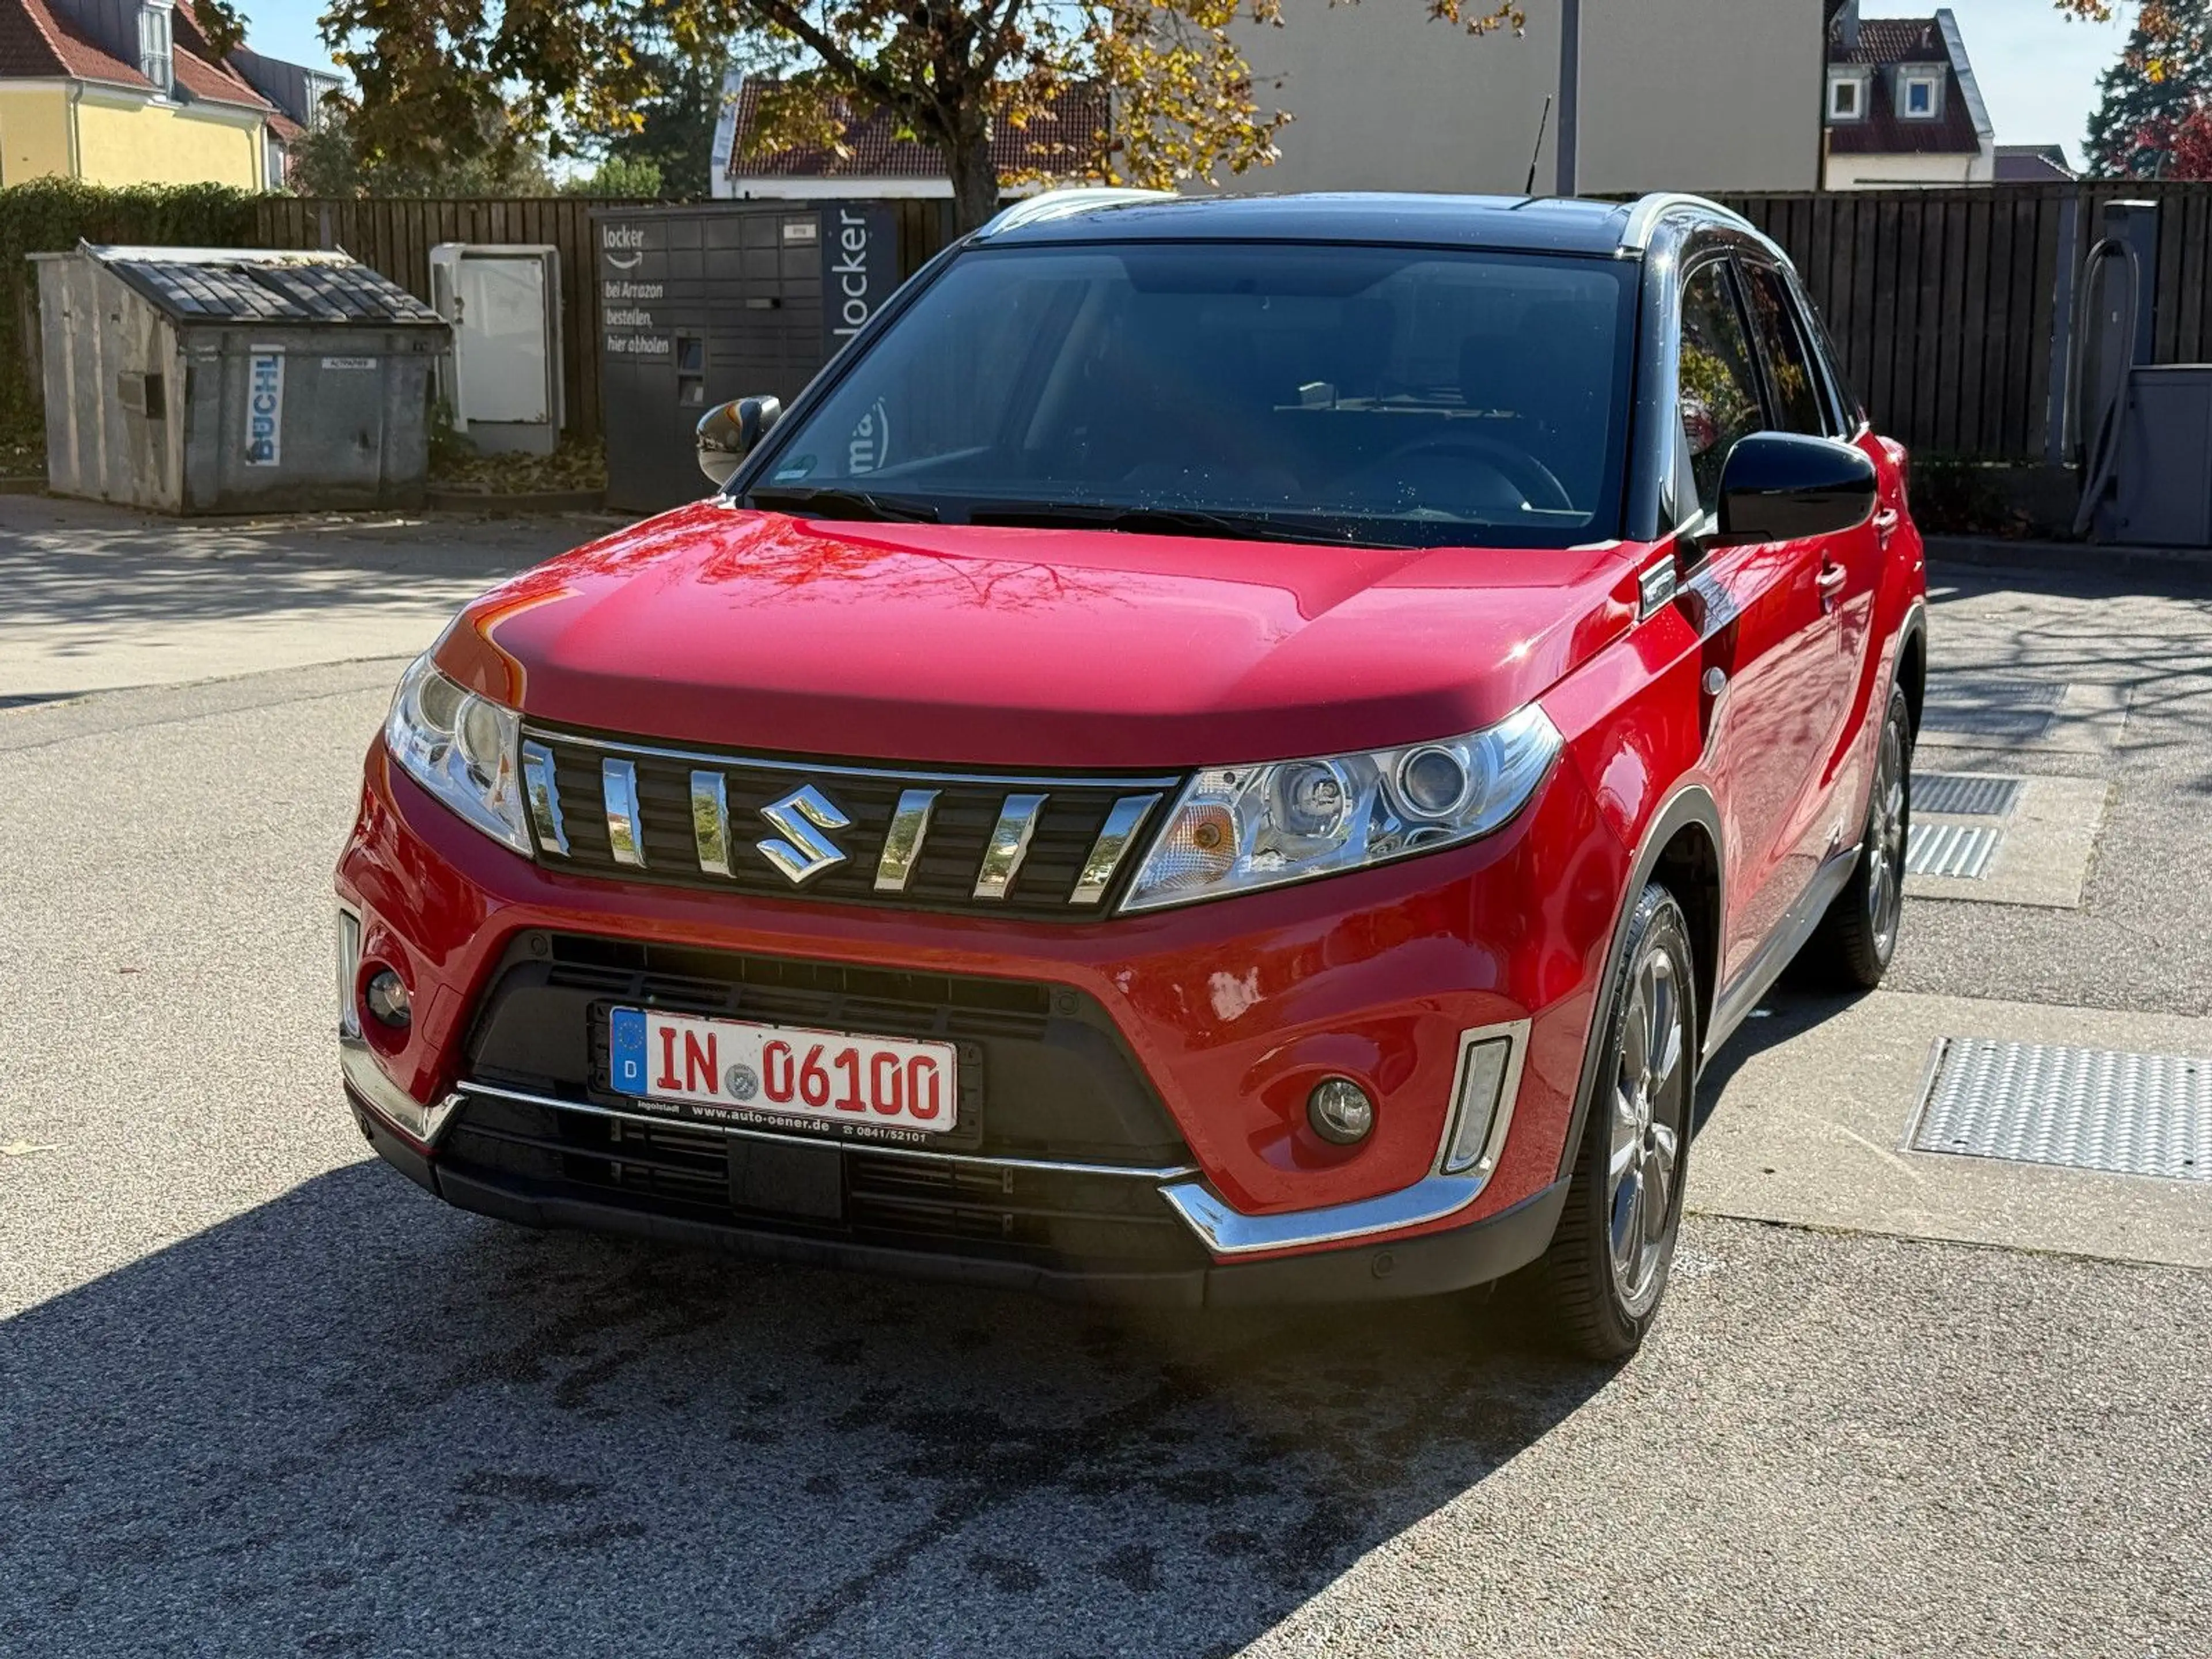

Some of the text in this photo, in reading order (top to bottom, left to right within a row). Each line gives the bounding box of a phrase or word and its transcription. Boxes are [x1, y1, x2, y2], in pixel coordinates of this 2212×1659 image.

[603, 224, 644, 248] locker
[831, 208, 868, 335] locker
[606, 281, 663, 300] bei Amazon
[607, 308, 653, 329] bestellen,
[607, 334, 669, 354] hier abholen
[625, 1060, 637, 1078] D
[657, 1027, 718, 1094] IN
[763, 1039, 940, 1119] 06100
[637, 1100, 926, 1143] Ingolstadt www.auto-oener.de 0841/52101
